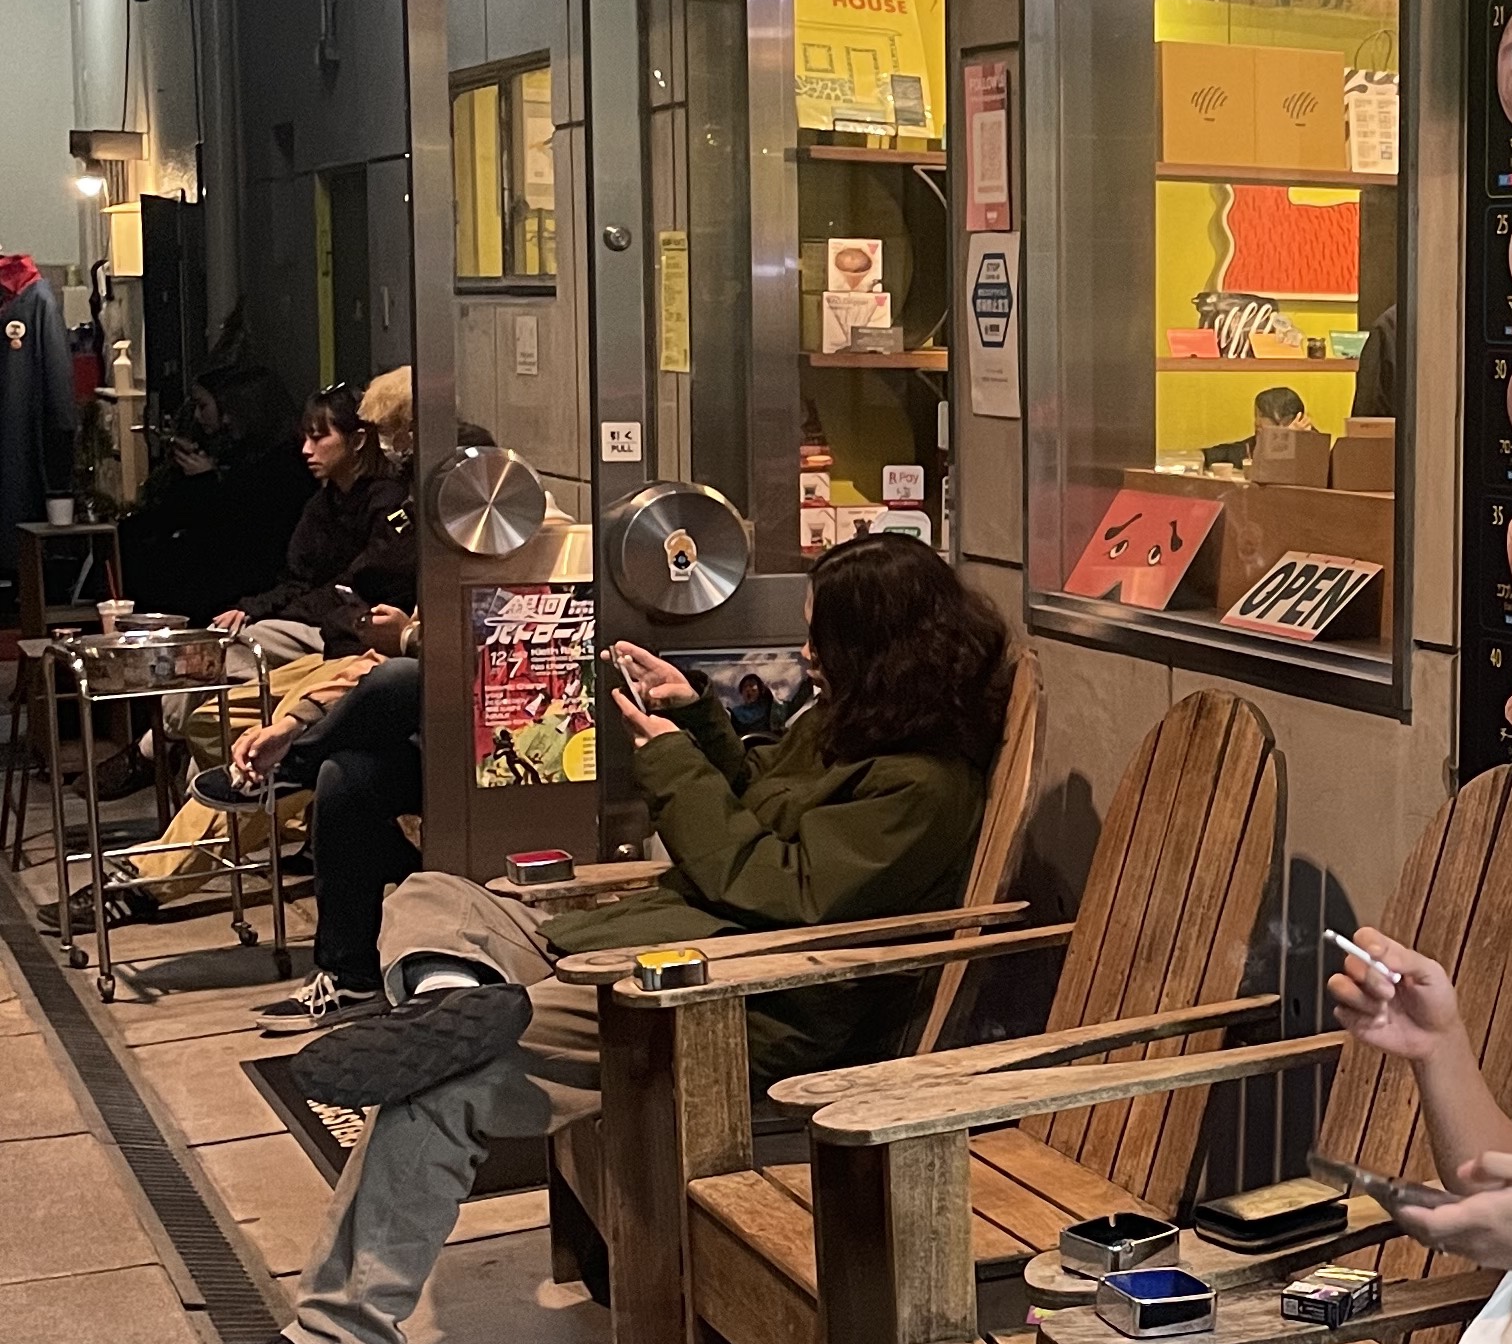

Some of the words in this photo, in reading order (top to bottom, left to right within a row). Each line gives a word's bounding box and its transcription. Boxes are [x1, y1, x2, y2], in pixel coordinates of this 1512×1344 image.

[1493, 5, 1505, 26] 21
[1496, 214, 1509, 235] 25
[1494, 359, 1507, 379] 30
[611, 444, 634, 453] PULL
[1492, 505, 1504, 525] 35
[1239, 561, 1370, 631] OPEN
